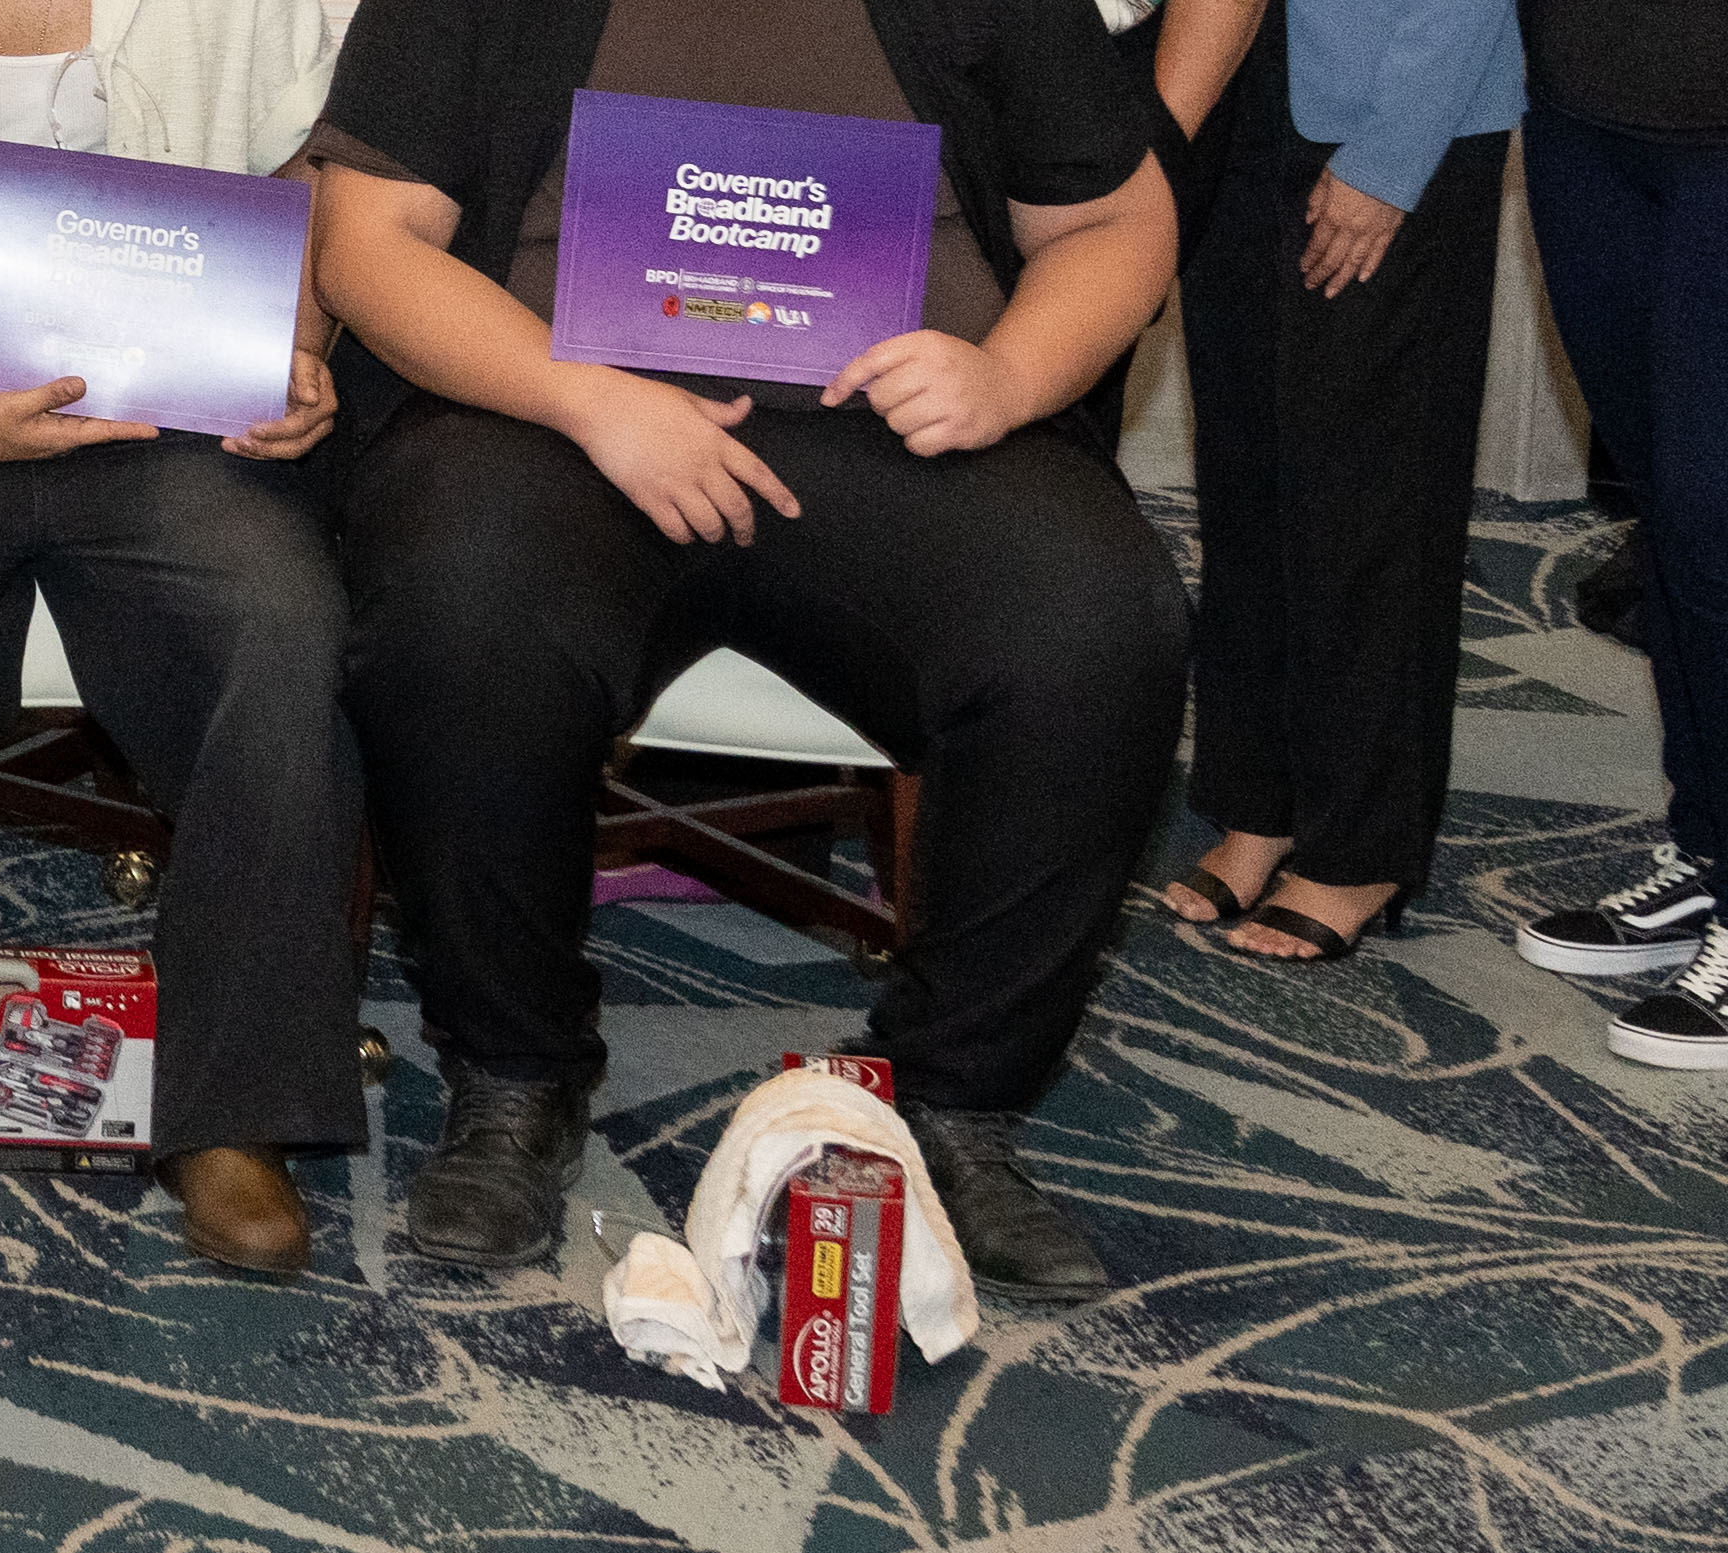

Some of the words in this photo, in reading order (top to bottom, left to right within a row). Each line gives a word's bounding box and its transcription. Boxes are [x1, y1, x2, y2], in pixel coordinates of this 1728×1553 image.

[676, 163, 827, 203] Governor's
[55, 209, 200, 251] Governor's
[669, 215, 821, 258] Bootcamp
[645, 269, 678, 285] BPD
[814, 1208, 834, 1232] 39
[852, 1251, 873, 1282] Set
[849, 1287, 870, 1327] Tool
[811, 1316, 832, 1401] APOLLO
[845, 1332, 868, 1405] General
